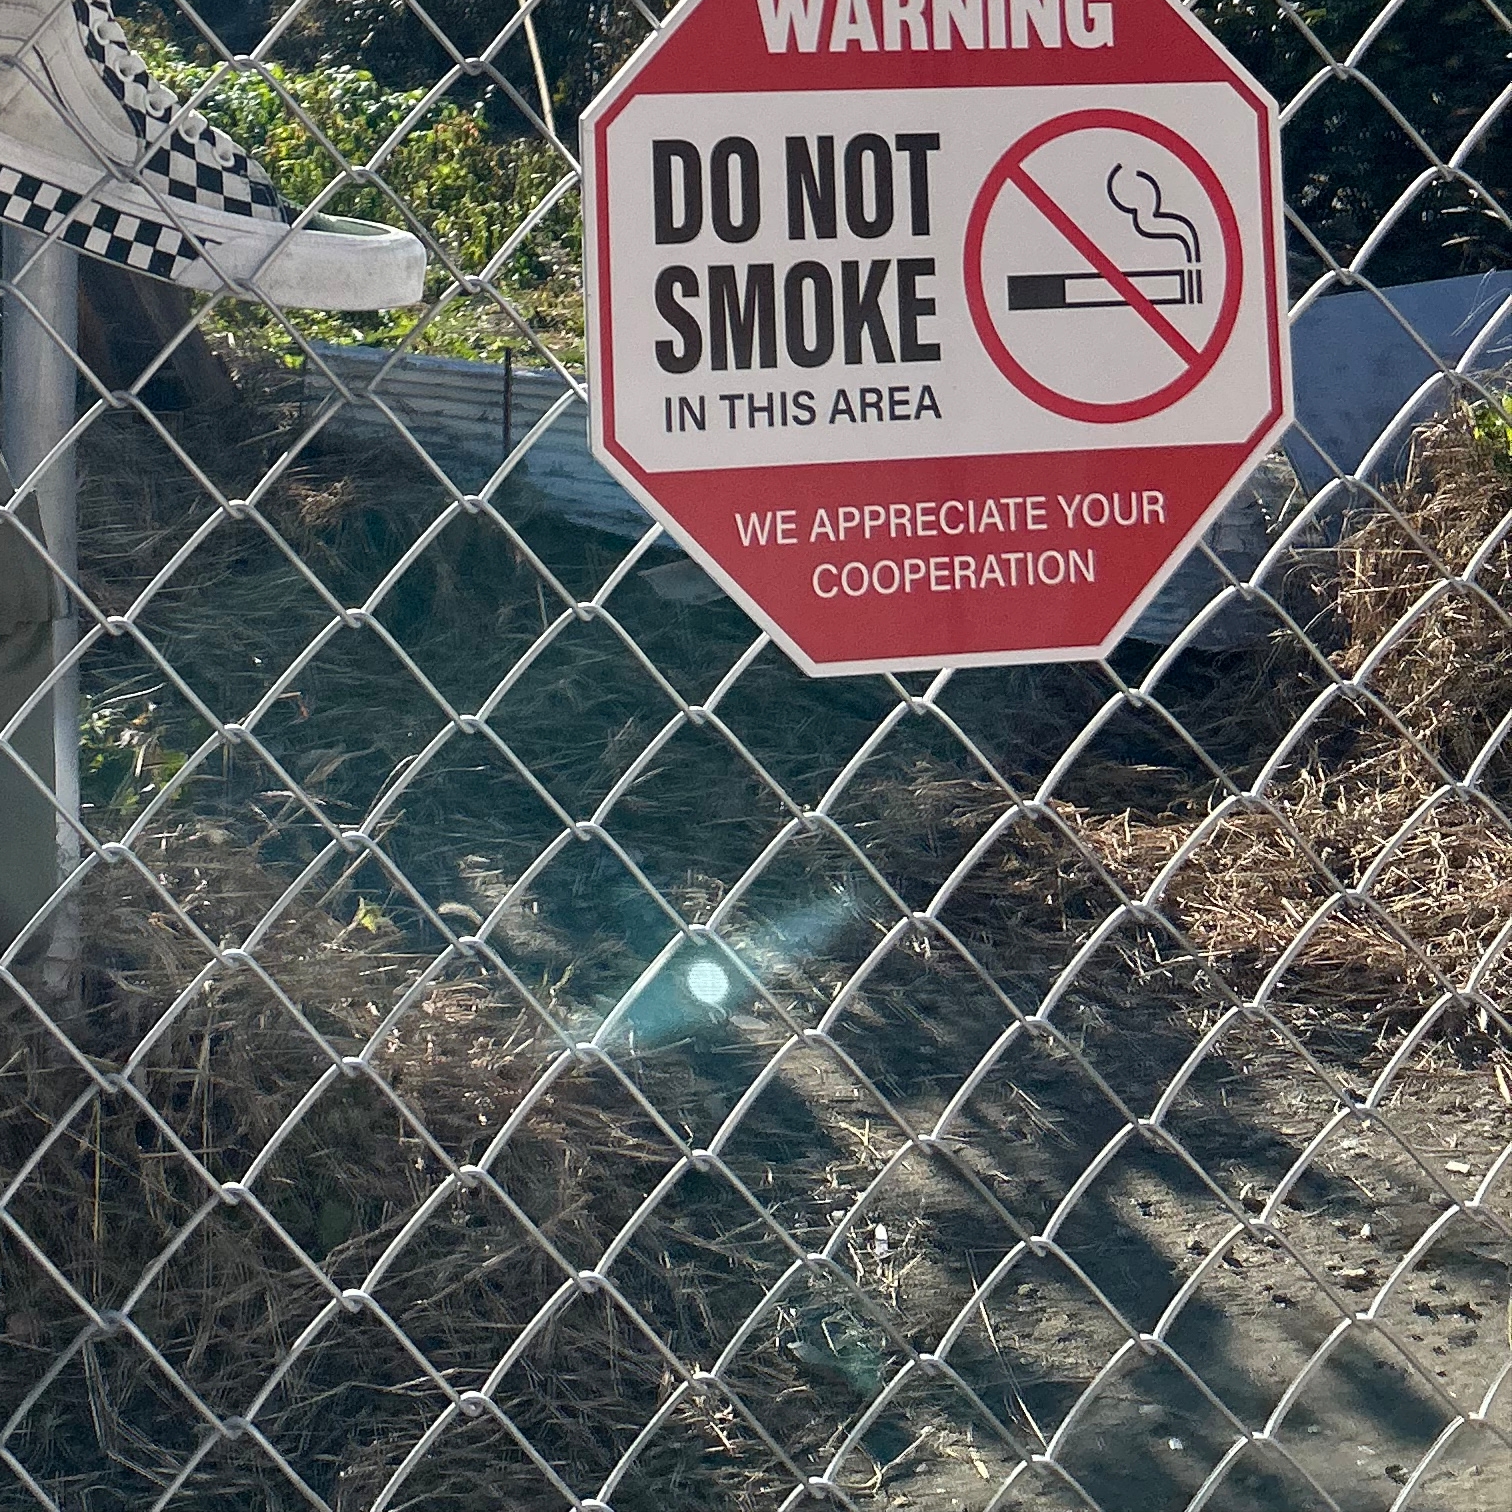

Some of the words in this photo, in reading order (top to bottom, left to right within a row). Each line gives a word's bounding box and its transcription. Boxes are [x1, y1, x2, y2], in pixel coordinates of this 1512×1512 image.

[652, 136, 760, 245] DO
[786, 133, 940, 240] NOT
[655, 258, 941, 374] SMOKE
[666, 396, 706, 432] IN
[719, 391, 816, 429] THIS
[829, 385, 942, 424] AREA
[735, 510, 798, 546] WE
[810, 497, 1047, 542] APPRECIATE
[1058, 491, 1164, 528] YOUR
[813, 549, 1094, 598] COOPERATION
